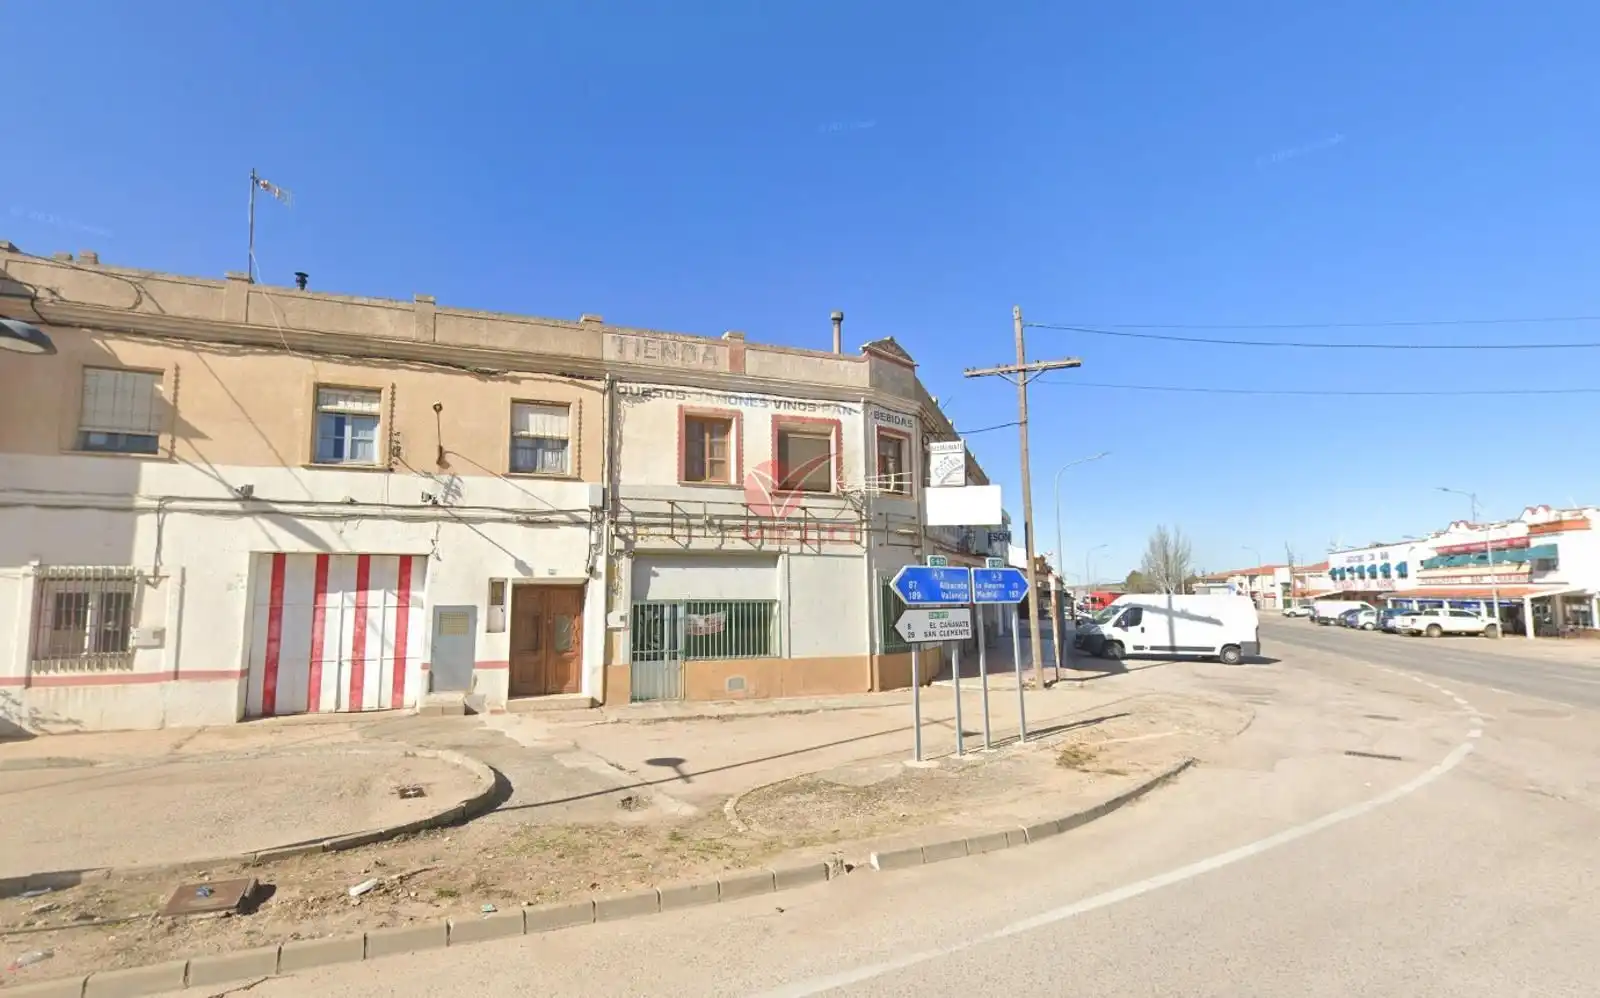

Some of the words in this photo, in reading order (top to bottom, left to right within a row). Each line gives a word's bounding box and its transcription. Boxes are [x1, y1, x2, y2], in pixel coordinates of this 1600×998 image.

[611, 336, 718, 365] TIENDA
[616, 385, 688, 401] QUESOS
[773, 399, 817, 412] VINOS
[873, 411, 913, 428] BEBIDAS
[939, 581, 968, 590] Albacete
[941, 591, 968, 600] Valencia
[929, 621, 936, 629] EL
[924, 630, 936, 638] SAN
[939, 629, 970, 638] CLEMENTE
